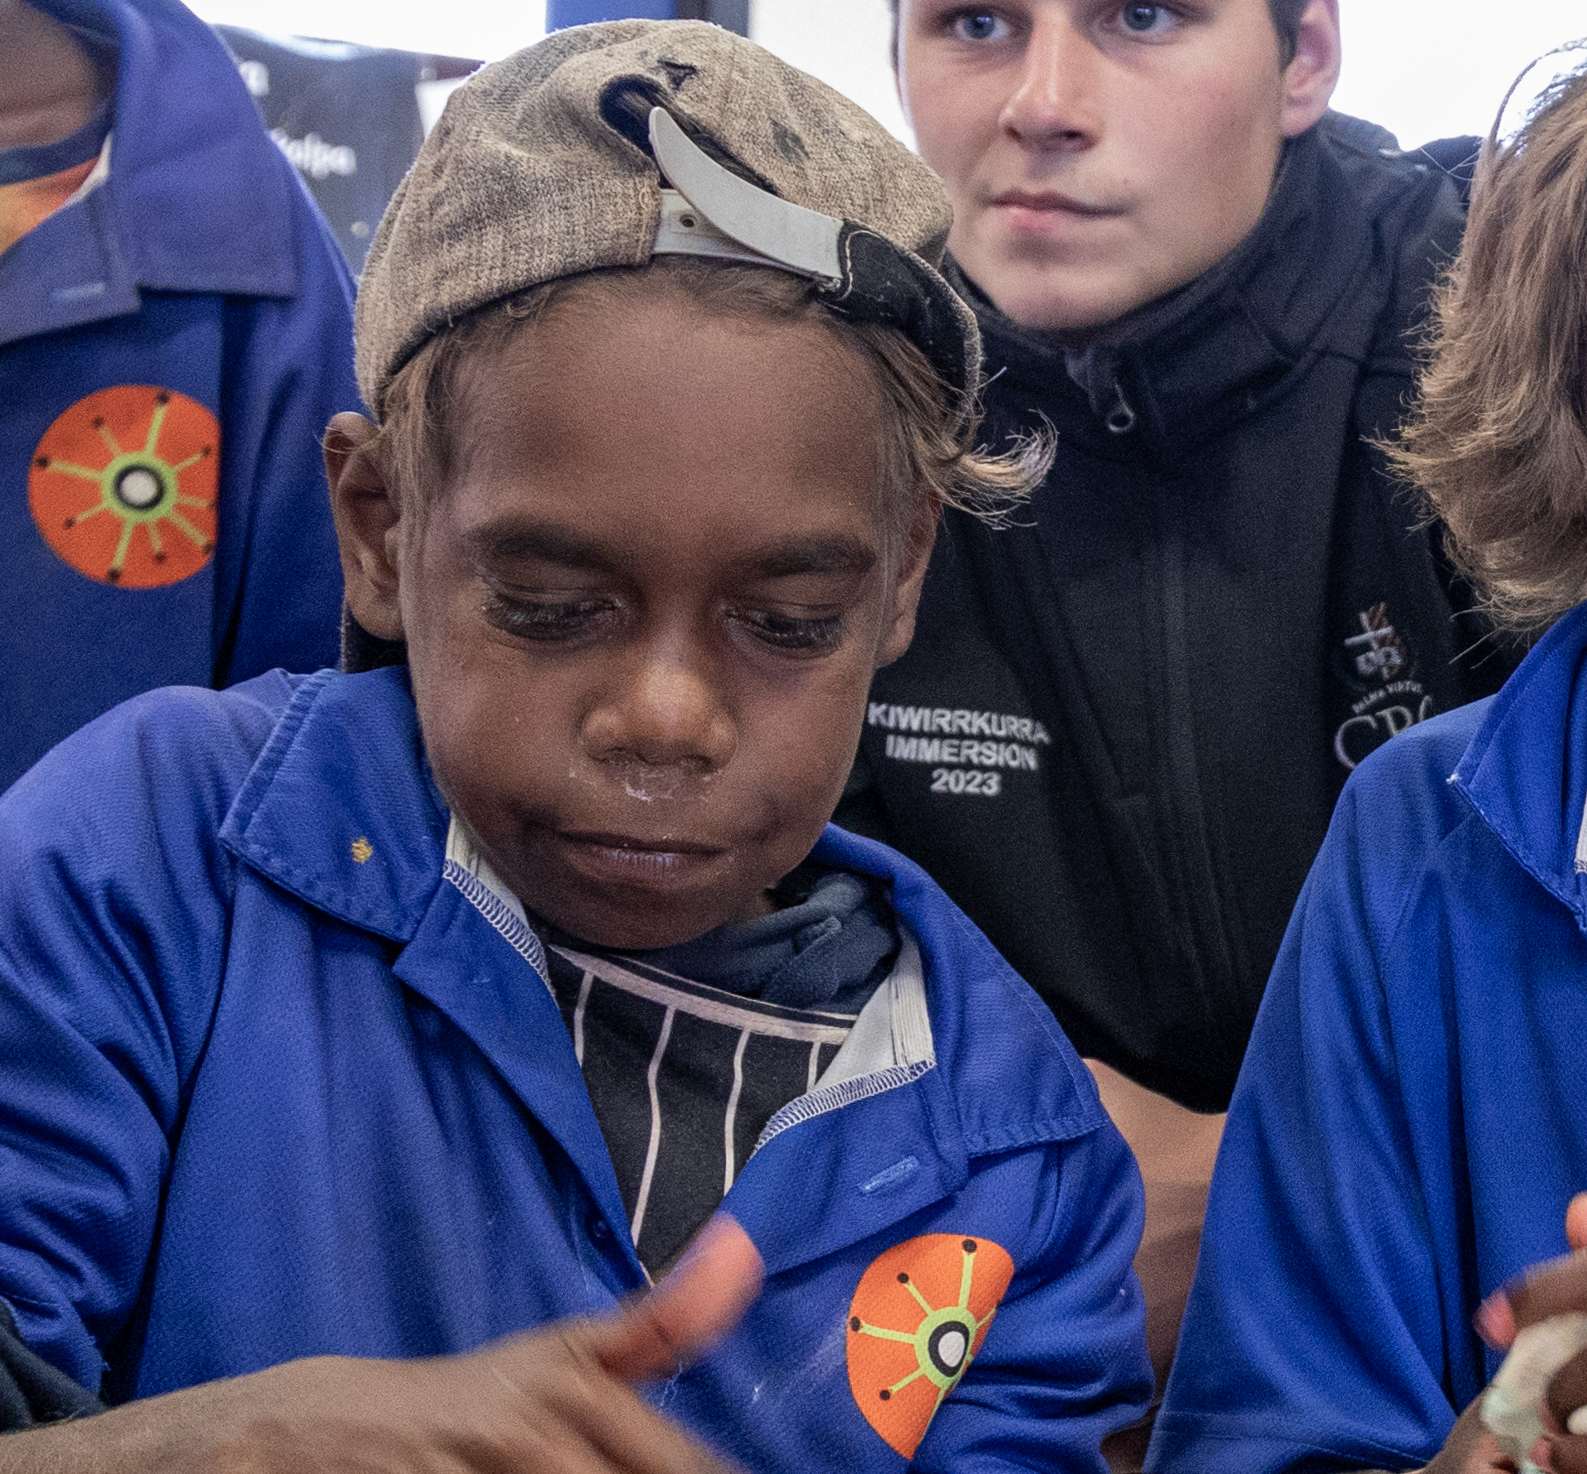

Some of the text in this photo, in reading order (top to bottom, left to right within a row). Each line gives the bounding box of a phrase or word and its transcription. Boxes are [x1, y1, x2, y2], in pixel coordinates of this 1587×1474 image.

[867, 701, 1054, 747] KIWIRRKURRA
[885, 733, 1040, 772] IMMERSION
[930, 767, 1002, 798] 2023
